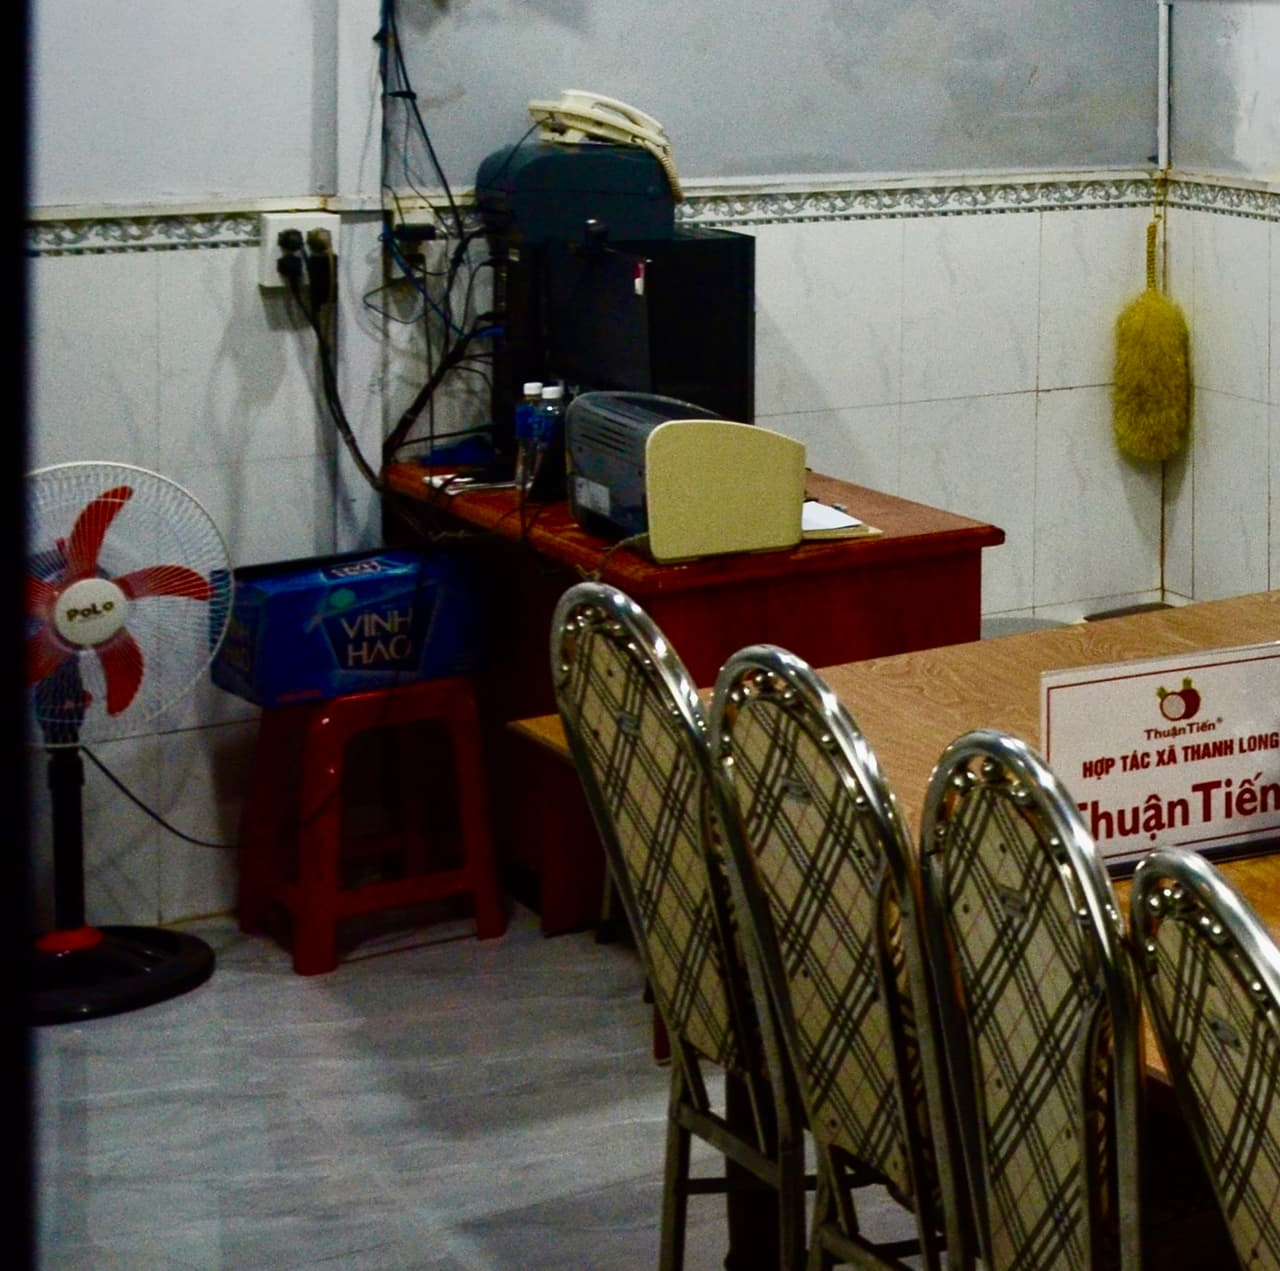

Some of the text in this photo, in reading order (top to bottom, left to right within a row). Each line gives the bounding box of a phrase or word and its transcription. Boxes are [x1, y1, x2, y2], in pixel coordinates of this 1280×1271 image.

[1144, 720, 1215, 740] Thuận Tiến
[1083, 732, 1280, 779] HỢP TÁC XÃ THANH LONG
